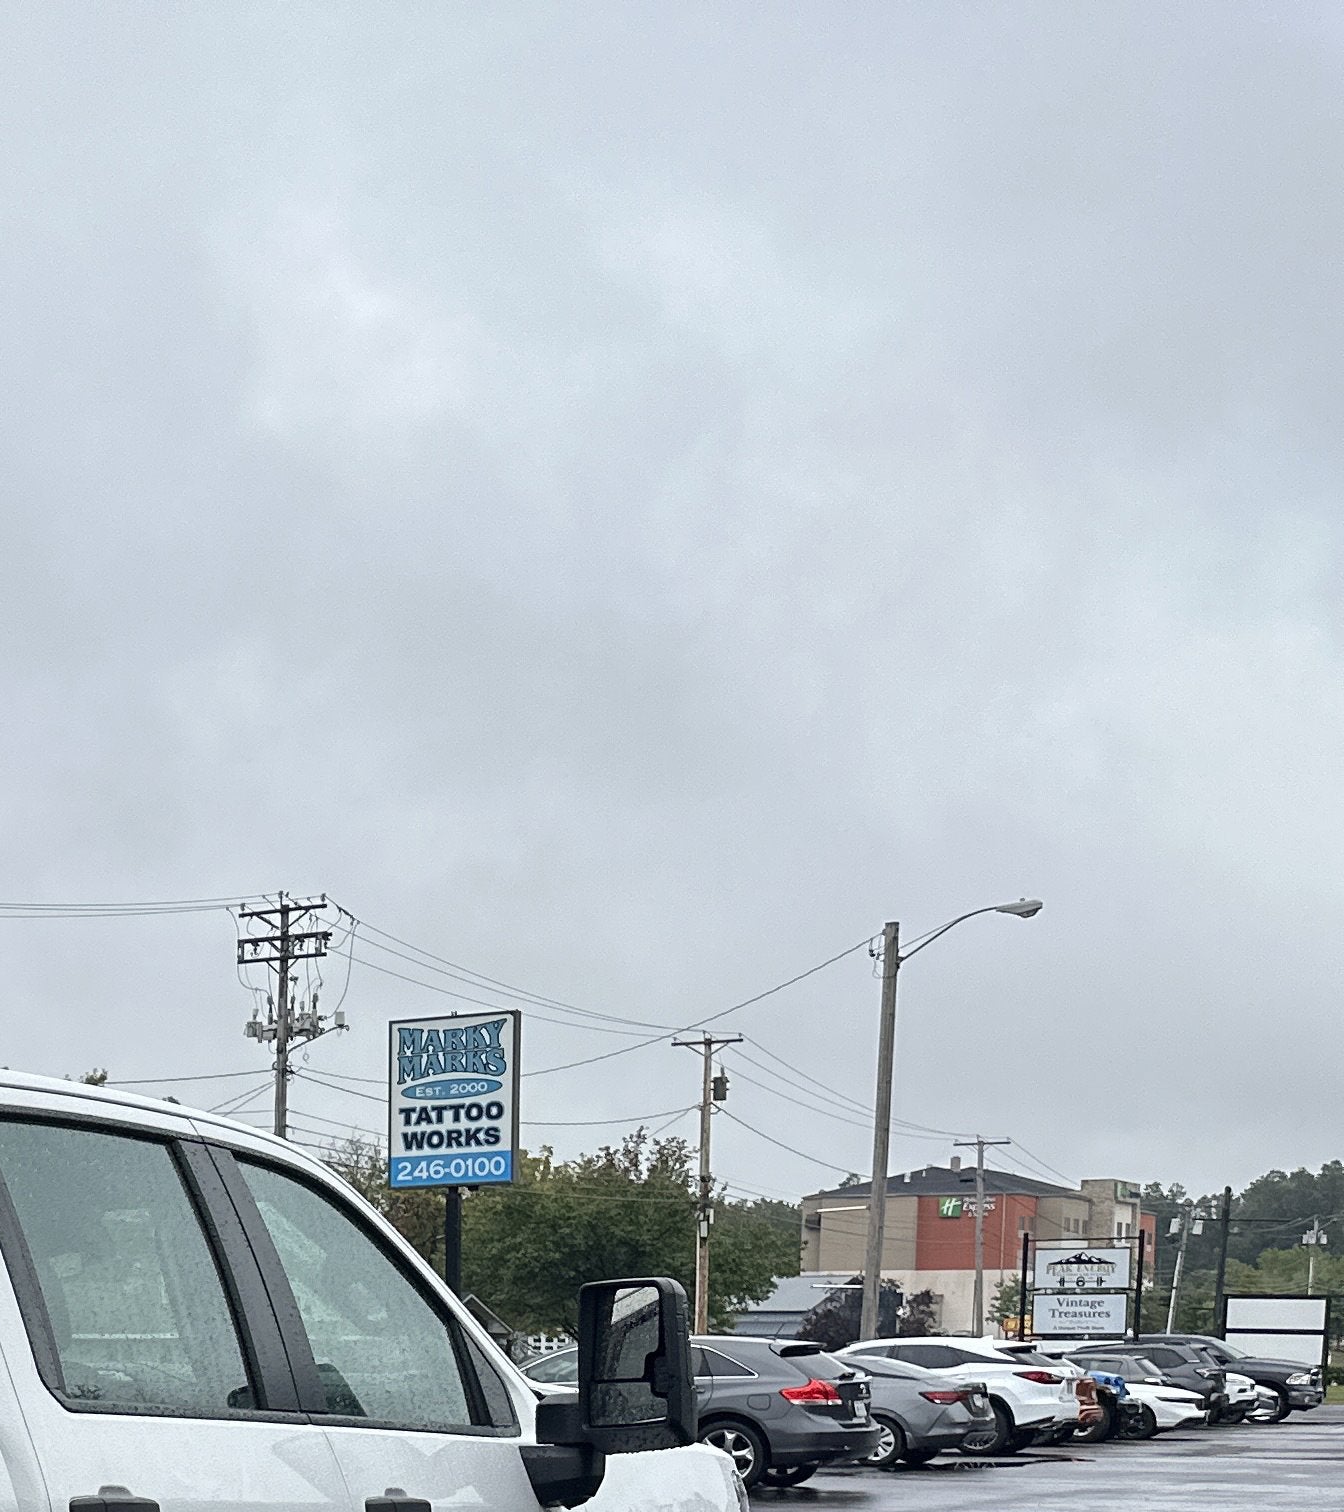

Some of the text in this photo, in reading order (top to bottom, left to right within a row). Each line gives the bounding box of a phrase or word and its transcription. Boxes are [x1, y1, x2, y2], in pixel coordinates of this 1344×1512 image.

[397, 1018, 508, 1056] MARKY
[397, 1047, 507, 1085] MARKS
[450, 1081, 488, 1095] 2000
[399, 1101, 504, 1126] TATTOO
[401, 1127, 501, 1151] WORKS
[397, 1156, 505, 1181] 246-0100
[1048, 1308, 1111, 1319] Treasures
[1056, 1298, 1105, 1310] Vintage
